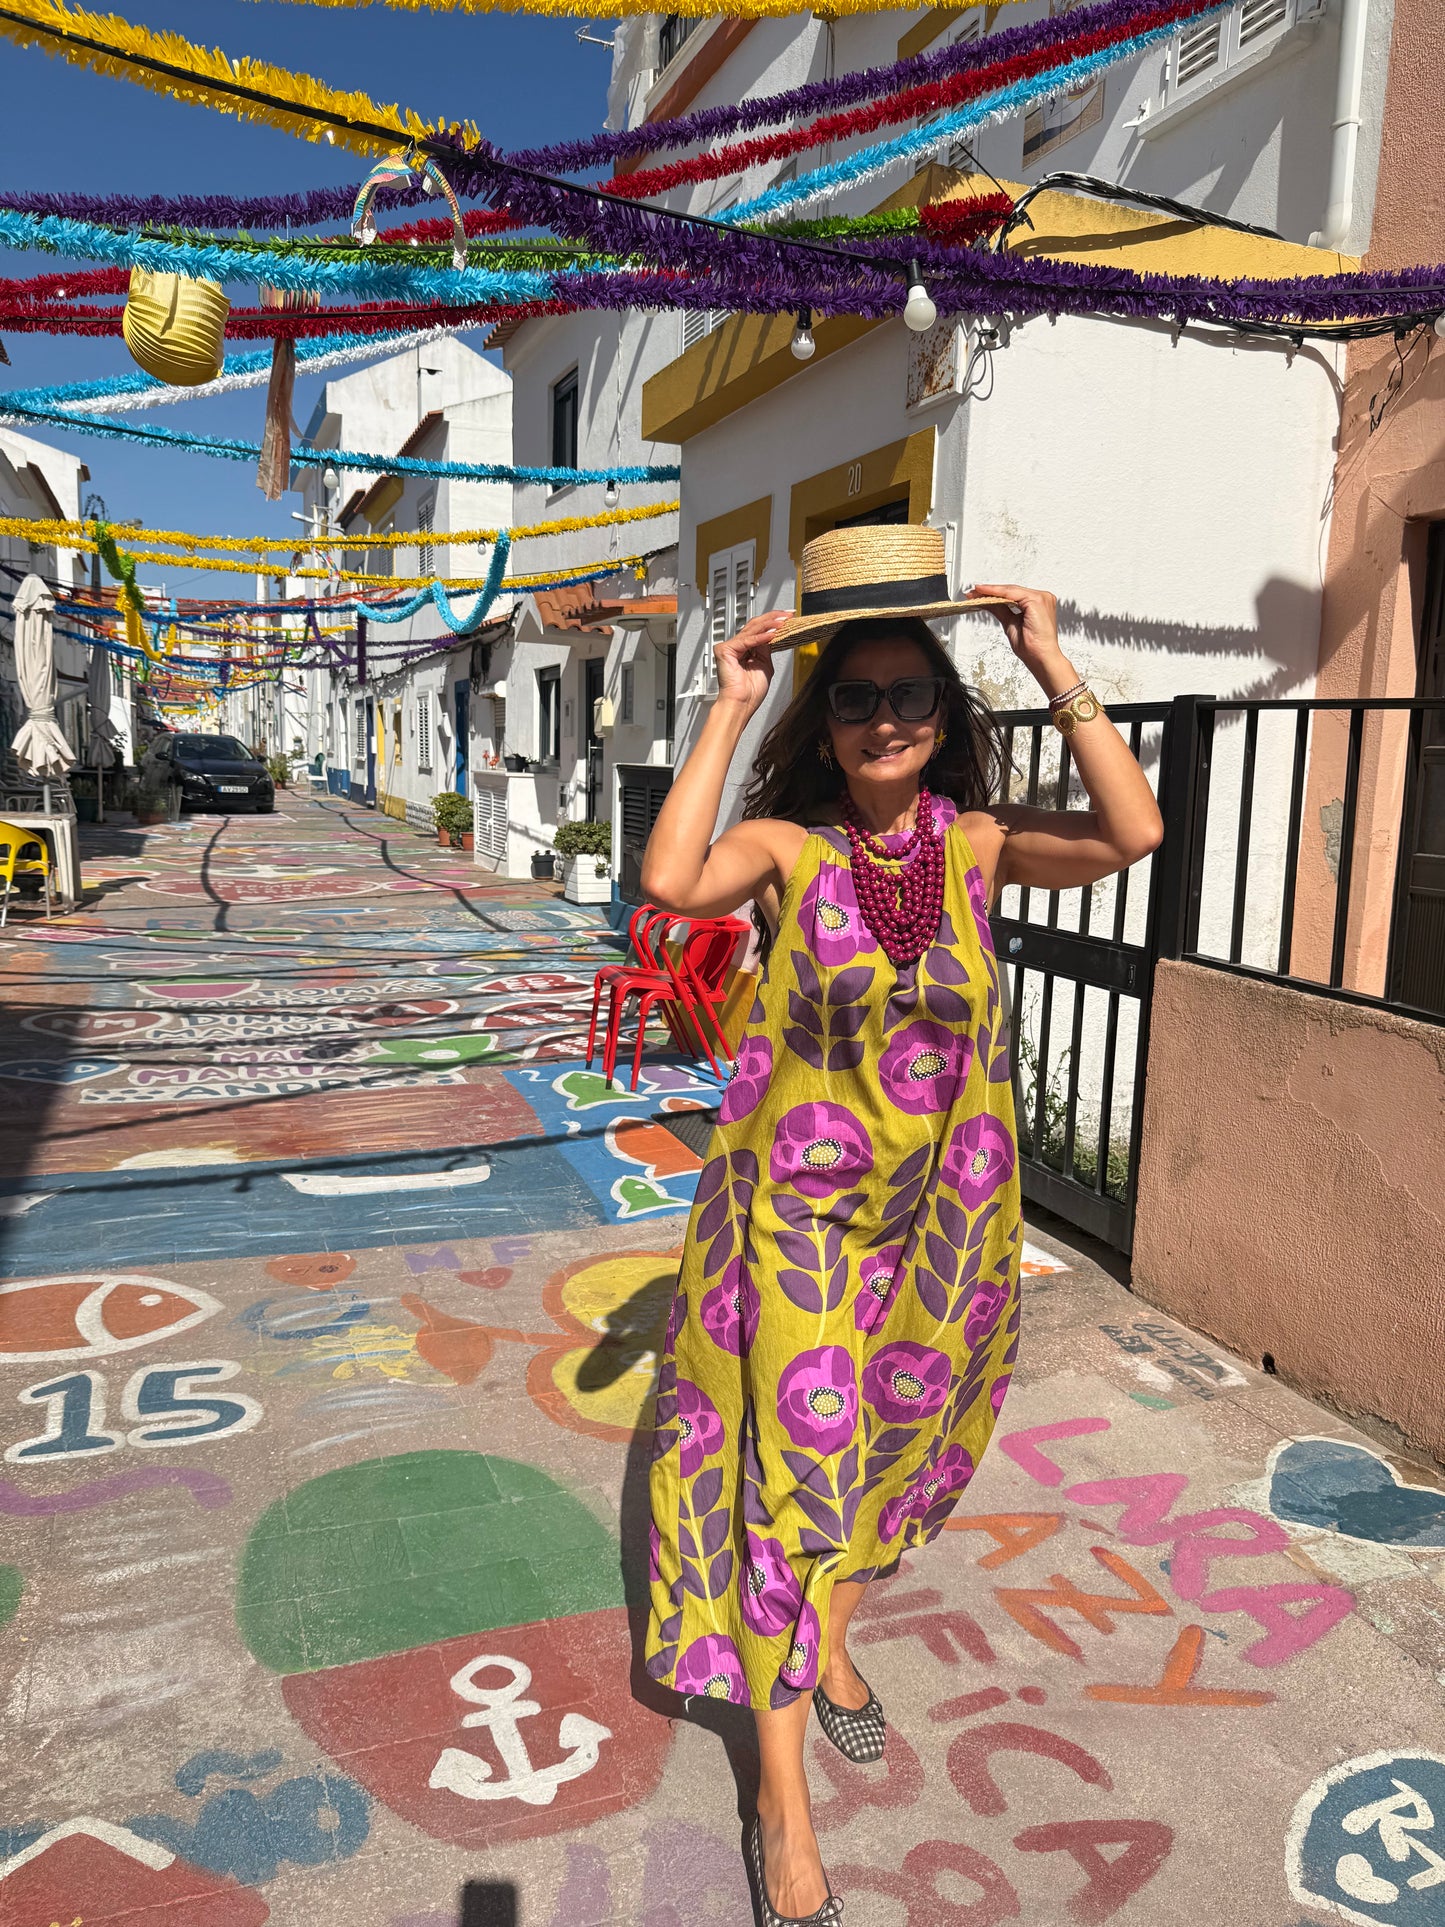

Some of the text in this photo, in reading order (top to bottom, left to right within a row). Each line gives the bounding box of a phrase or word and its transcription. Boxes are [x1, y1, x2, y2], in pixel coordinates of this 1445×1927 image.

[848, 463, 862, 497] 20
[146, 916, 320, 931] RUA
[257, 981, 443, 997] TOMÁS
[140, 996, 376, 1009] FRANCISCO
[51, 1017, 137, 1030] NM
[186, 1013, 319, 1027] DINIS
[152, 1022, 368, 1039] MANUEL
[136, 1062, 363, 1085] MARTA
[174, 1069, 393, 1099] ANDRÉ
[491, 1239, 532, 1265] F
[5, 1360, 263, 1464] 15
[1000, 1417, 1358, 1668] LARA
